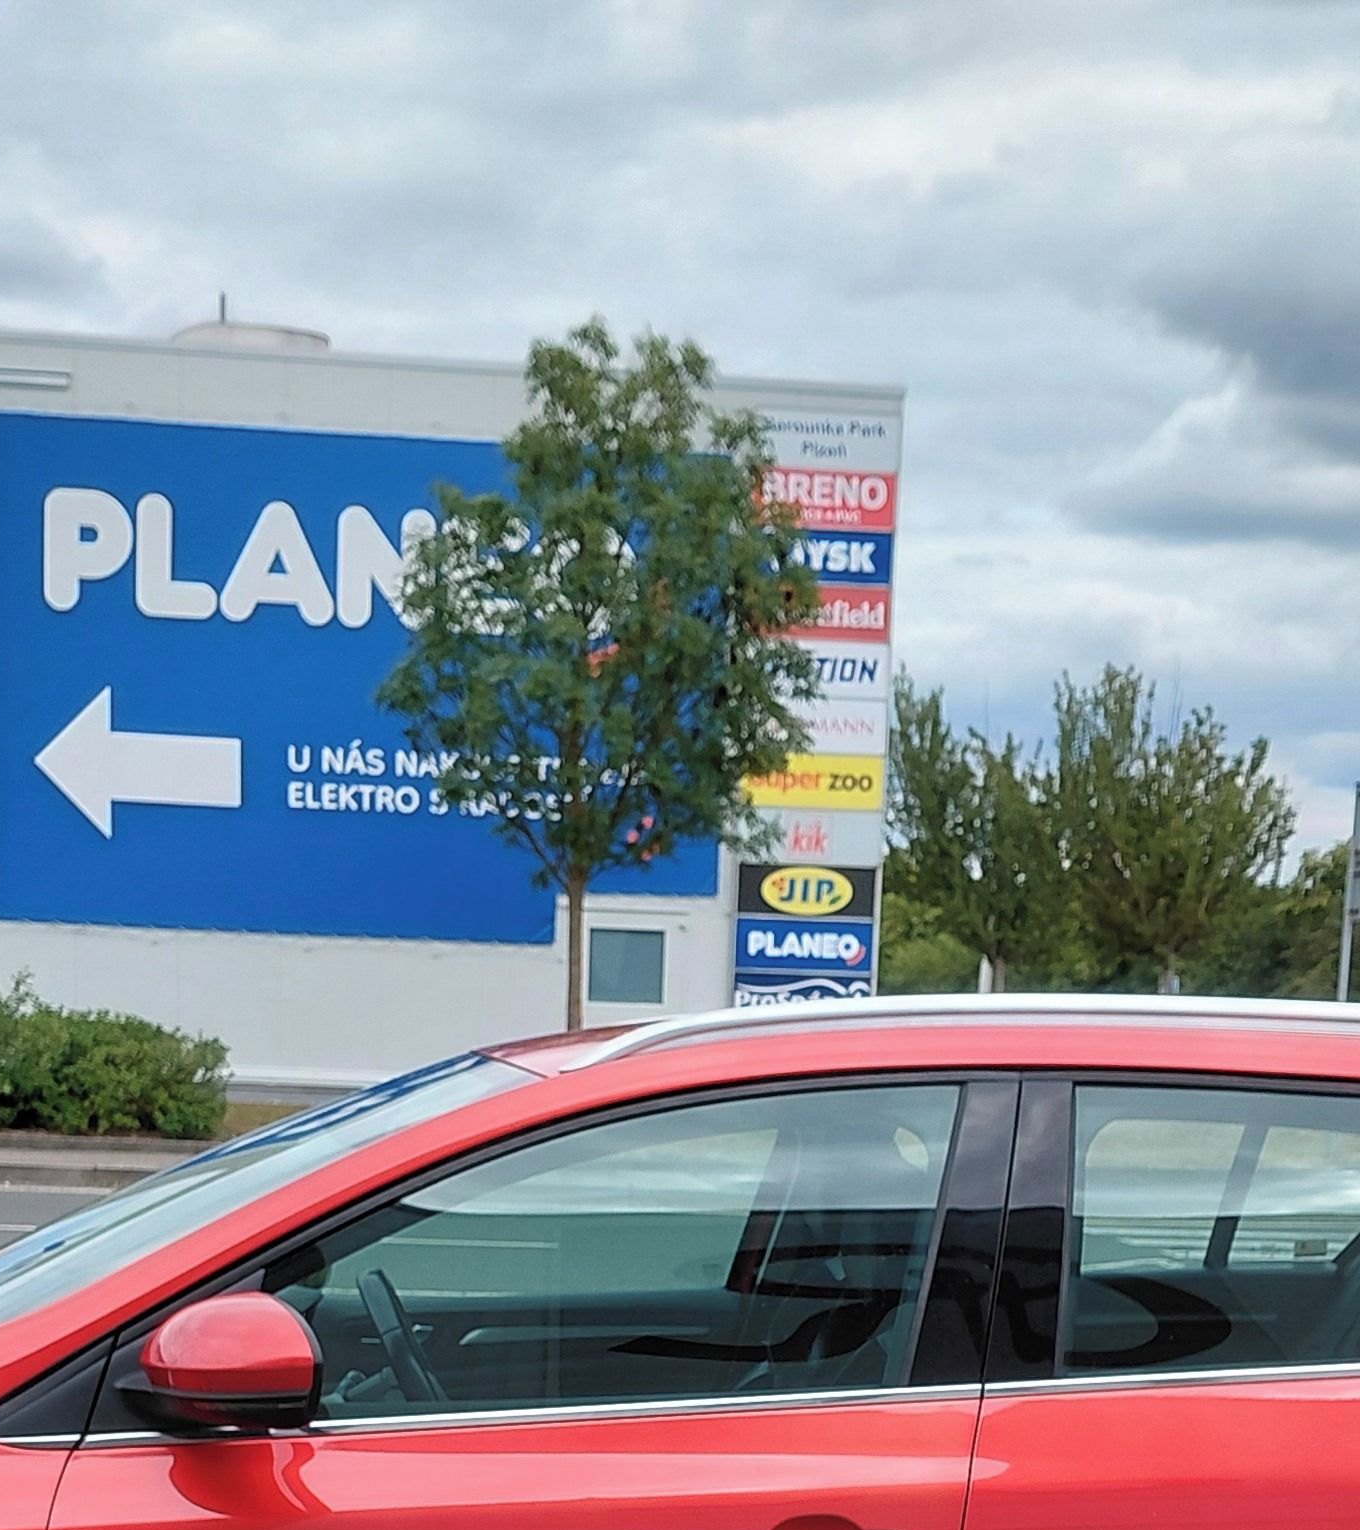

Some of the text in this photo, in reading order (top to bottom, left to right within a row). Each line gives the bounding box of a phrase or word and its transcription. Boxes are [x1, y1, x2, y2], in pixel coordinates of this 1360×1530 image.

[287, 744, 311, 773] U
[321, 738, 385, 777] NÁS
[287, 782, 420, 815] ELEKTRO
[779, 877, 835, 903] JIP
[747, 929, 862, 962] PLANEO
